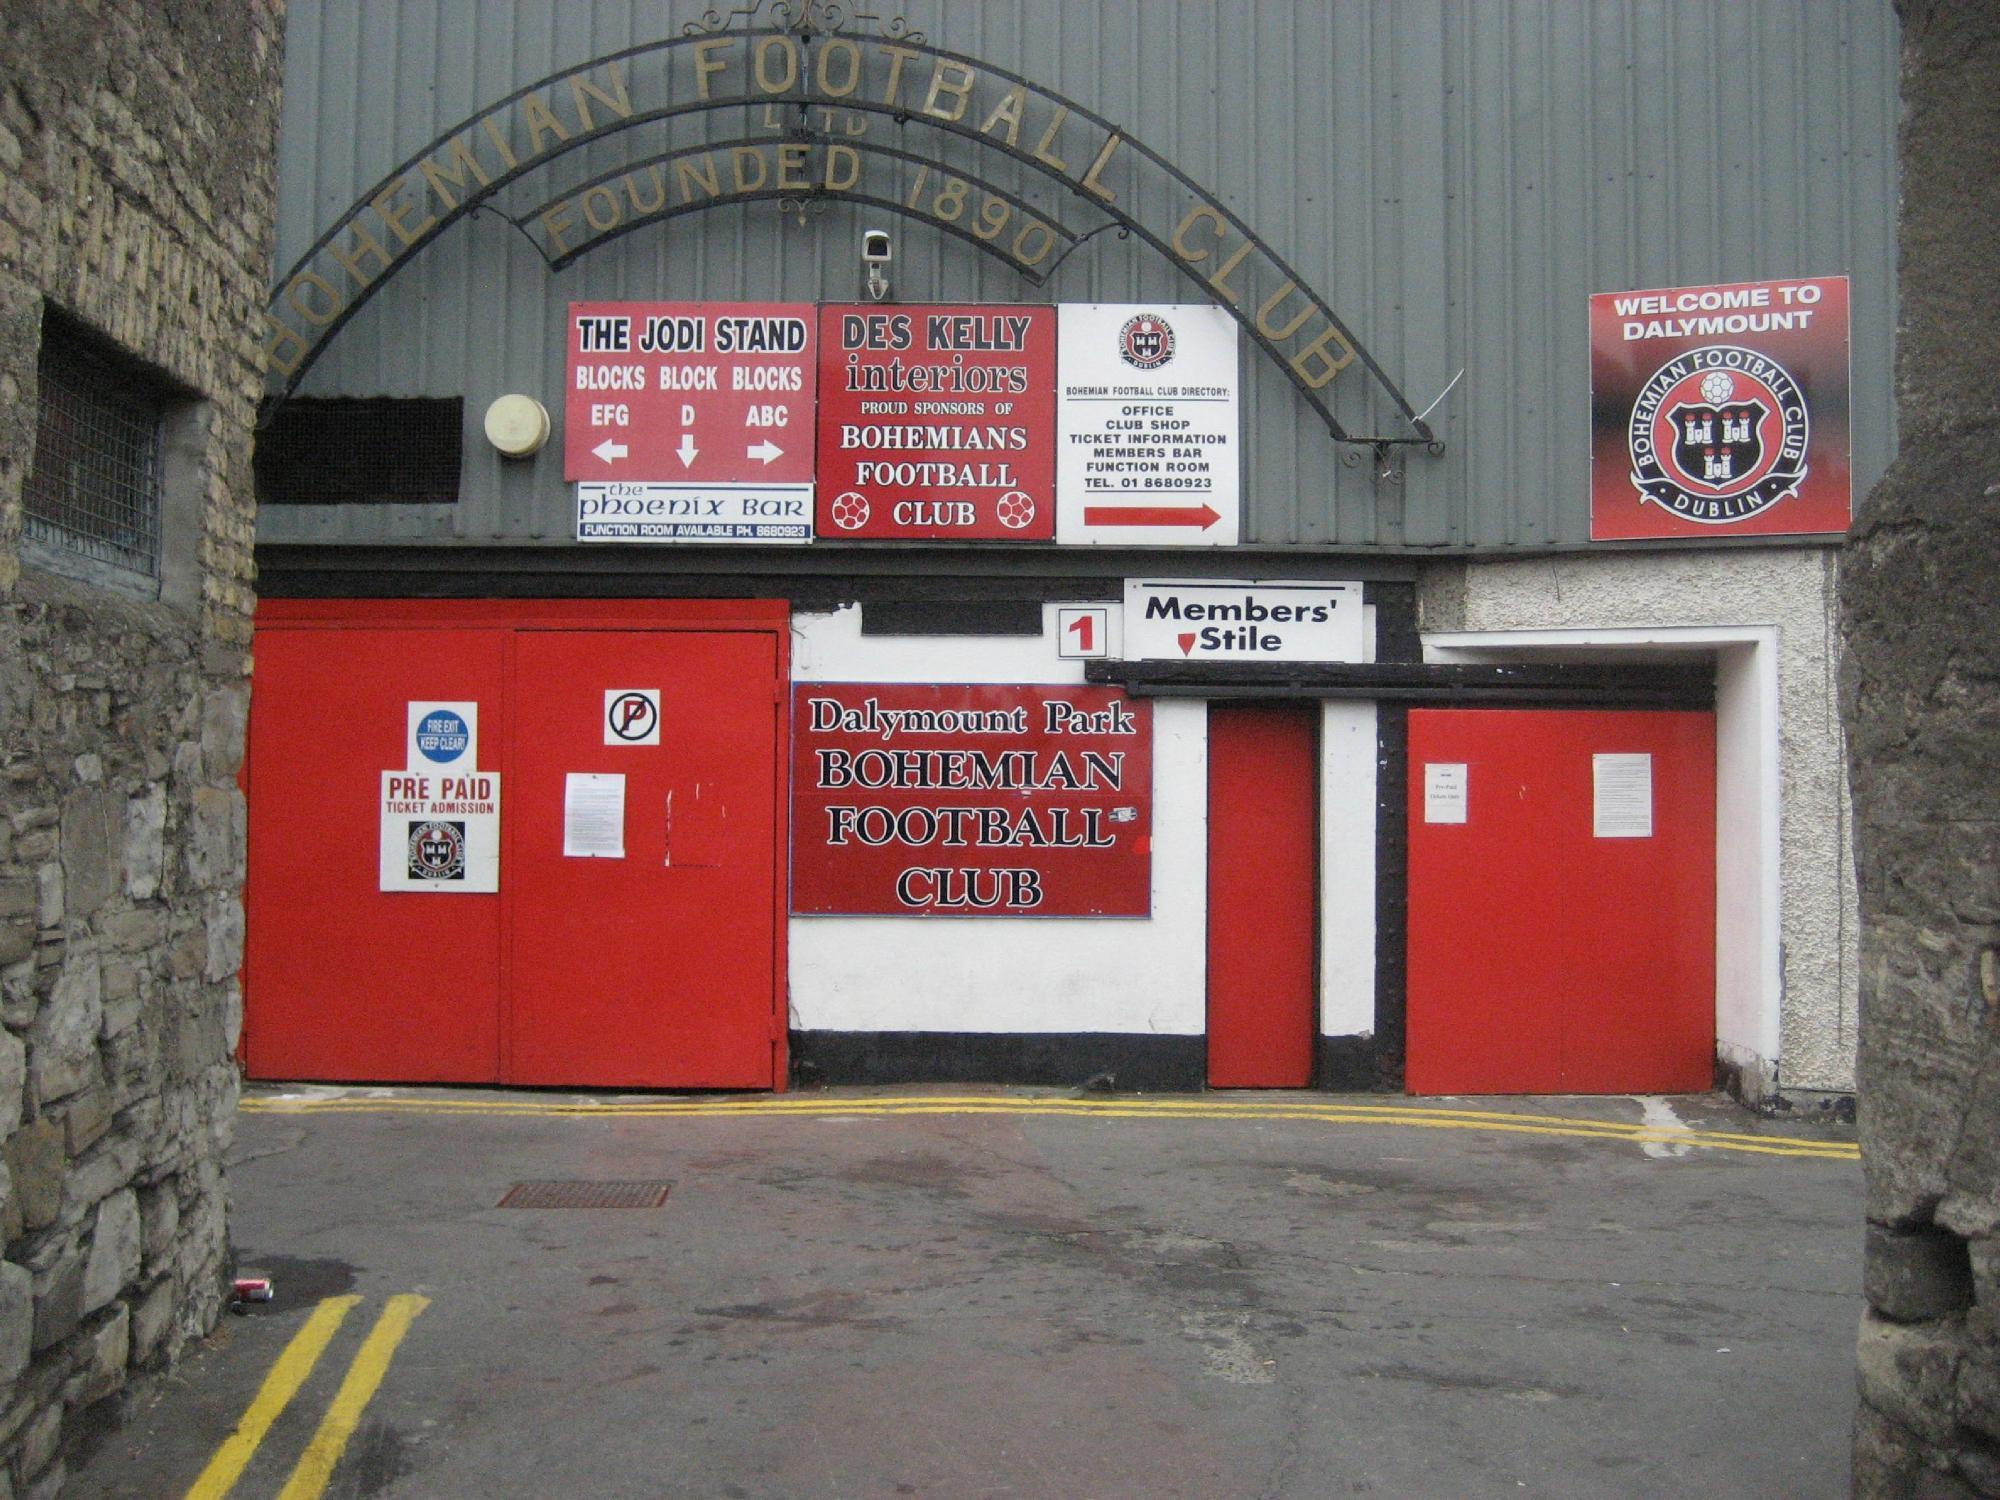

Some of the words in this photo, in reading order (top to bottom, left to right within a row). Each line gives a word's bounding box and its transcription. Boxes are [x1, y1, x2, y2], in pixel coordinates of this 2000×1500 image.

[539, 143, 860, 254] FOUNDED
[907, 164, 1060, 266] 1890
[694, 35, 1123, 202] FOOTBALL
[1171, 206, 1357, 390] CLUB
[1614, 288, 1770, 316] WELCOME
[1778, 285, 1821, 305] TO
[576, 317, 630, 352] THE
[639, 317, 705, 352] JODI
[715, 317, 806, 353] STAND
[843, 315, 912, 350] DES
[927, 316, 1031, 351] KELLY
[1623, 311, 1812, 341] DALYMOUNT
[576, 366, 645, 390] BLOCKS
[660, 366, 718, 390] BLOCK
[733, 366, 802, 391] BLOCKS
[845, 353, 1027, 393] interiors
[1066, 387, 1109, 396] BOHEMIAN
[1113, 387, 1154, 396] FOOTBALL
[1157, 387, 1178, 396] CLUB
[1181, 388, 1230, 397] DIRECTORY:
[591, 404, 629, 426] EFG
[681, 405, 695, 426] D
[746, 405, 788, 427] ABC
[861, 402, 907, 414] PROUD
[914, 402, 984, 415] SPONSORS
[995, 403, 1013, 415] OF
[1122, 406, 1174, 416] OFFICE
[1633, 362, 1688, 467] BOHEMIAN
[1692, 350, 1793, 402] FOOTBALL
[1782, 406, 1804, 460] CLUB
[840, 425, 1027, 450] BOHEMIANS
[1106, 420, 1143, 430] CLUB
[1150, 420, 1190, 430] SHOP
[1069, 434, 1121, 444] TICKET
[1128, 434, 1227, 444] INFORMATION
[1093, 448, 1166, 458] MEMBERS
[1173, 448, 1202, 459] BAR
[855, 462, 1017, 487] FOOTBALL
[1086, 462, 1160, 472] FUNCTION
[1166, 462, 1210, 472] ROOM
[609, 483, 643, 496] the
[1085, 478, 1115, 488] TEL.
[1121, 478, 1138, 488] 01
[1144, 478, 1212, 488] 8680923
[580, 493, 725, 519] phoenix
[893, 502, 976, 525] CLUB
[1673, 490, 1763, 517] DUBLIN
[585, 524, 639, 536] FUNCTION
[641, 524, 673, 536] ROOM
[676, 525, 733, 536] AVAILABLE
[756, 525, 805, 537] 8680923
[1145, 596, 1337, 623] Members'
[1068, 616, 1093, 651] 1
[1200, 626, 1282, 651] Stile
[427, 719, 443, 733] FIRE
[444, 719, 459, 733] EXIT
[808, 698, 1027, 740] Dalymount
[1044, 700, 1137, 735] Park
[420, 737, 439, 749] KEEP
[440, 737, 465, 750] CLEAR!
[816, 749, 1125, 790] BOHEMIAN
[390, 777, 430, 799] PRE
[442, 778, 491, 800] PAID
[386, 802, 425, 814] TICKET
[431, 802, 494, 814] ADMISSION
[826, 806, 1117, 847] FOOTBALL
[896, 867, 1042, 908] CLUB
